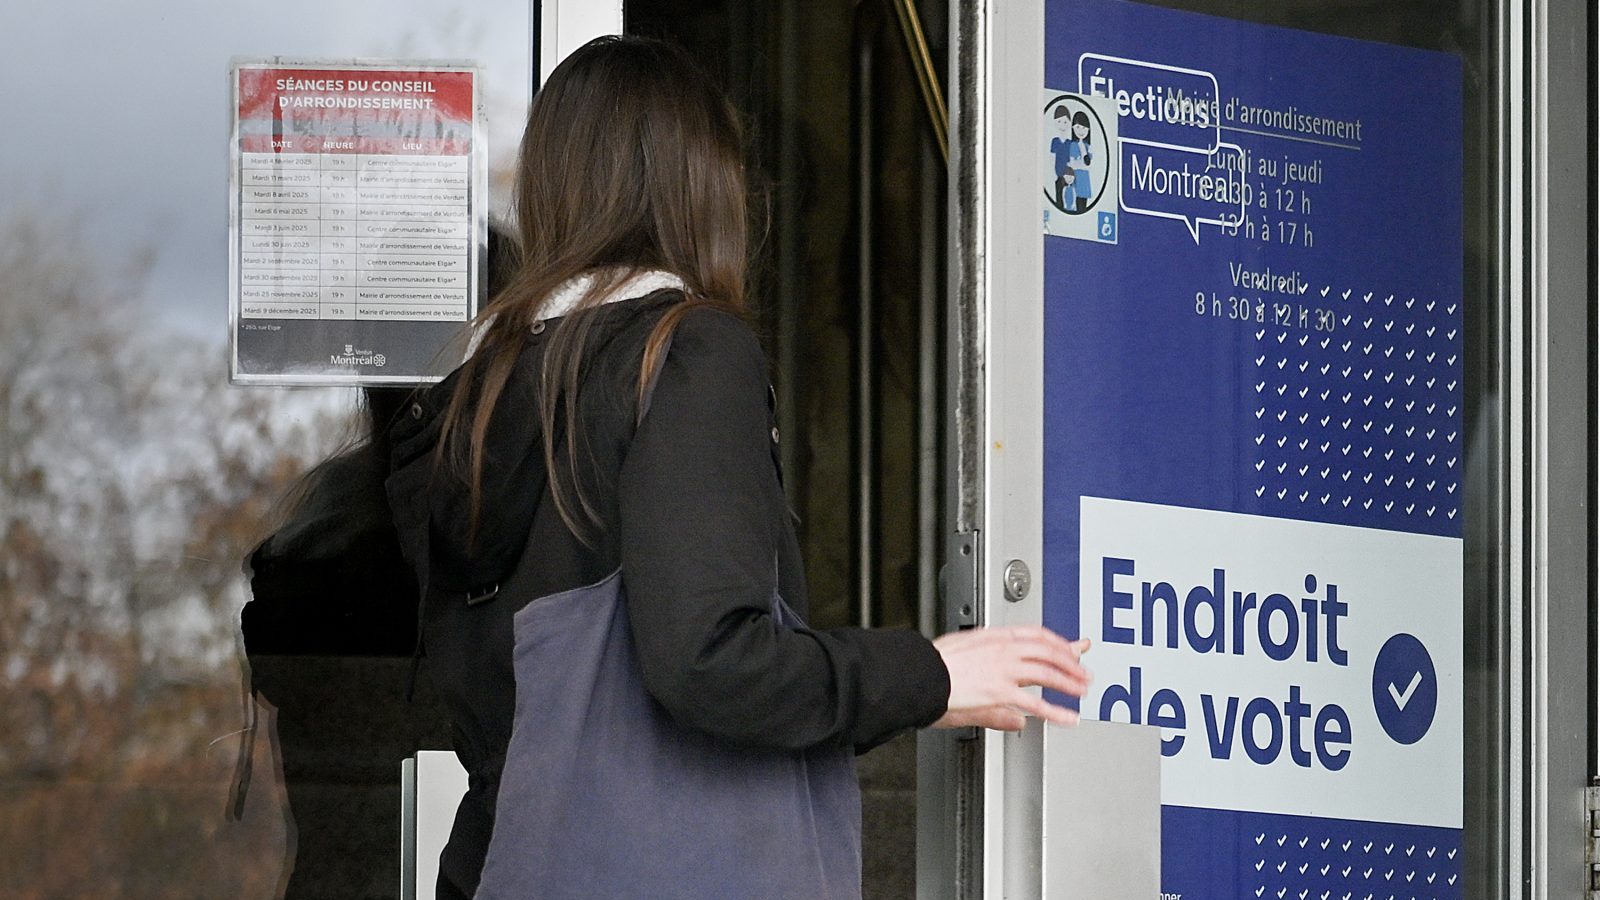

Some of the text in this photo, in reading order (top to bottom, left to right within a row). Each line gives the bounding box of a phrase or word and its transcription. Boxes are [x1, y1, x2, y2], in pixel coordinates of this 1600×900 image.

[276, 76, 436, 93] SÉANCES DU CONSEIL
[279, 96, 433, 110] D'ARRONDISSEMENT
[1090, 67, 1209, 129] Élections
[1225, 97, 1363, 141] d'arrondissement
[323, 141, 354, 150] HEURE
[1131, 154, 1233, 204] Montréal
[1208, 144, 1322, 185] Lundi au jeudi
[1259, 182, 1268, 209] à
[1275, 189, 1294, 213] 12
[1302, 191, 1311, 215] h
[1218, 213, 1313, 248] 13 h à 17 h
[1229, 262, 1300, 295] Vendredi
[1195, 292, 1206, 315] 8
[1212, 293, 1222, 317] h
[1228, 297, 1250, 321] 30
[1273, 303, 1291, 327] 12
[1314, 308, 1336, 332] 30
[330, 355, 373, 365] Montréal
[1101, 556, 1349, 667] Endroit
[1098, 666, 1352, 771] de vote
